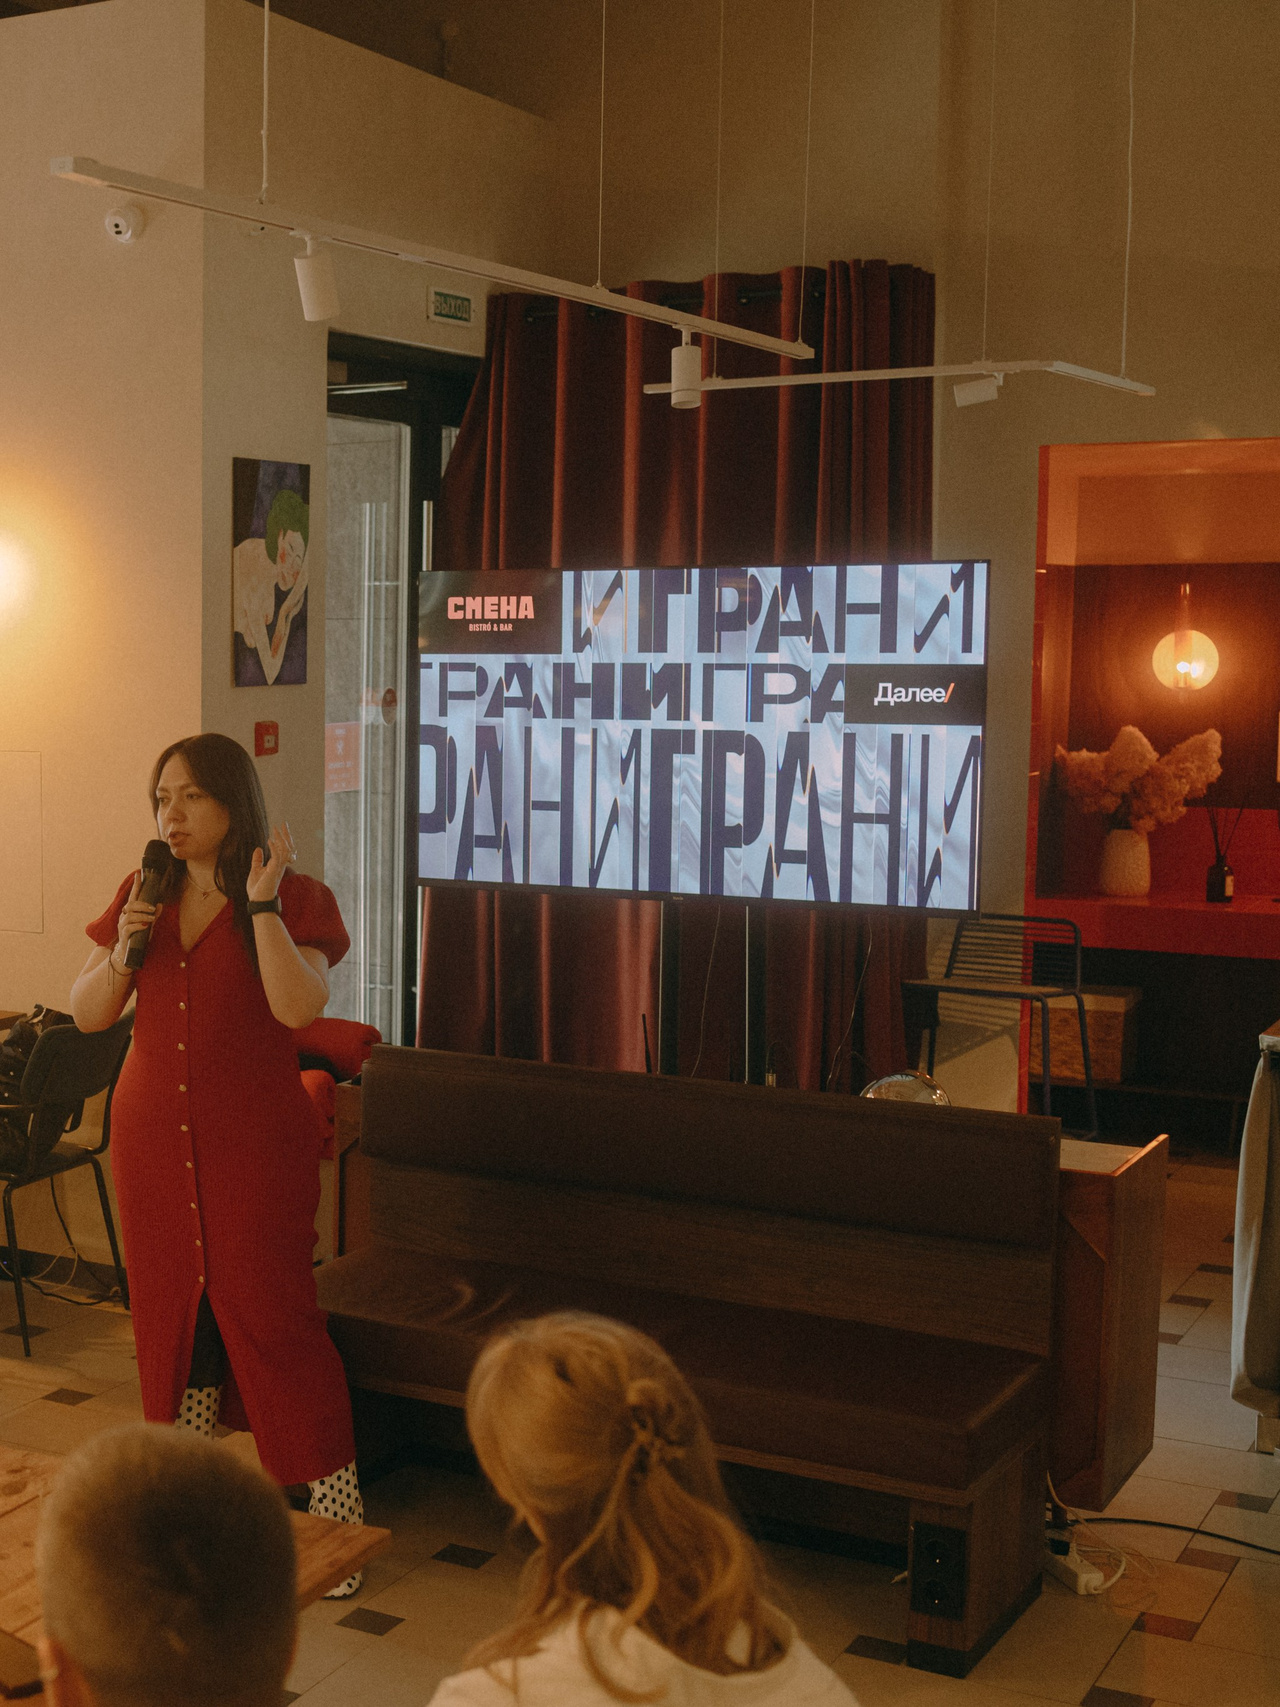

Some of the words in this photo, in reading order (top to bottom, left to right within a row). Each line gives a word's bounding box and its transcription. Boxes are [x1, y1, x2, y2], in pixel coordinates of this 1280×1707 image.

[447, 595, 535, 620] СМЕНА
[493, 623, 499, 631] &
[499, 623, 513, 631] BAR
